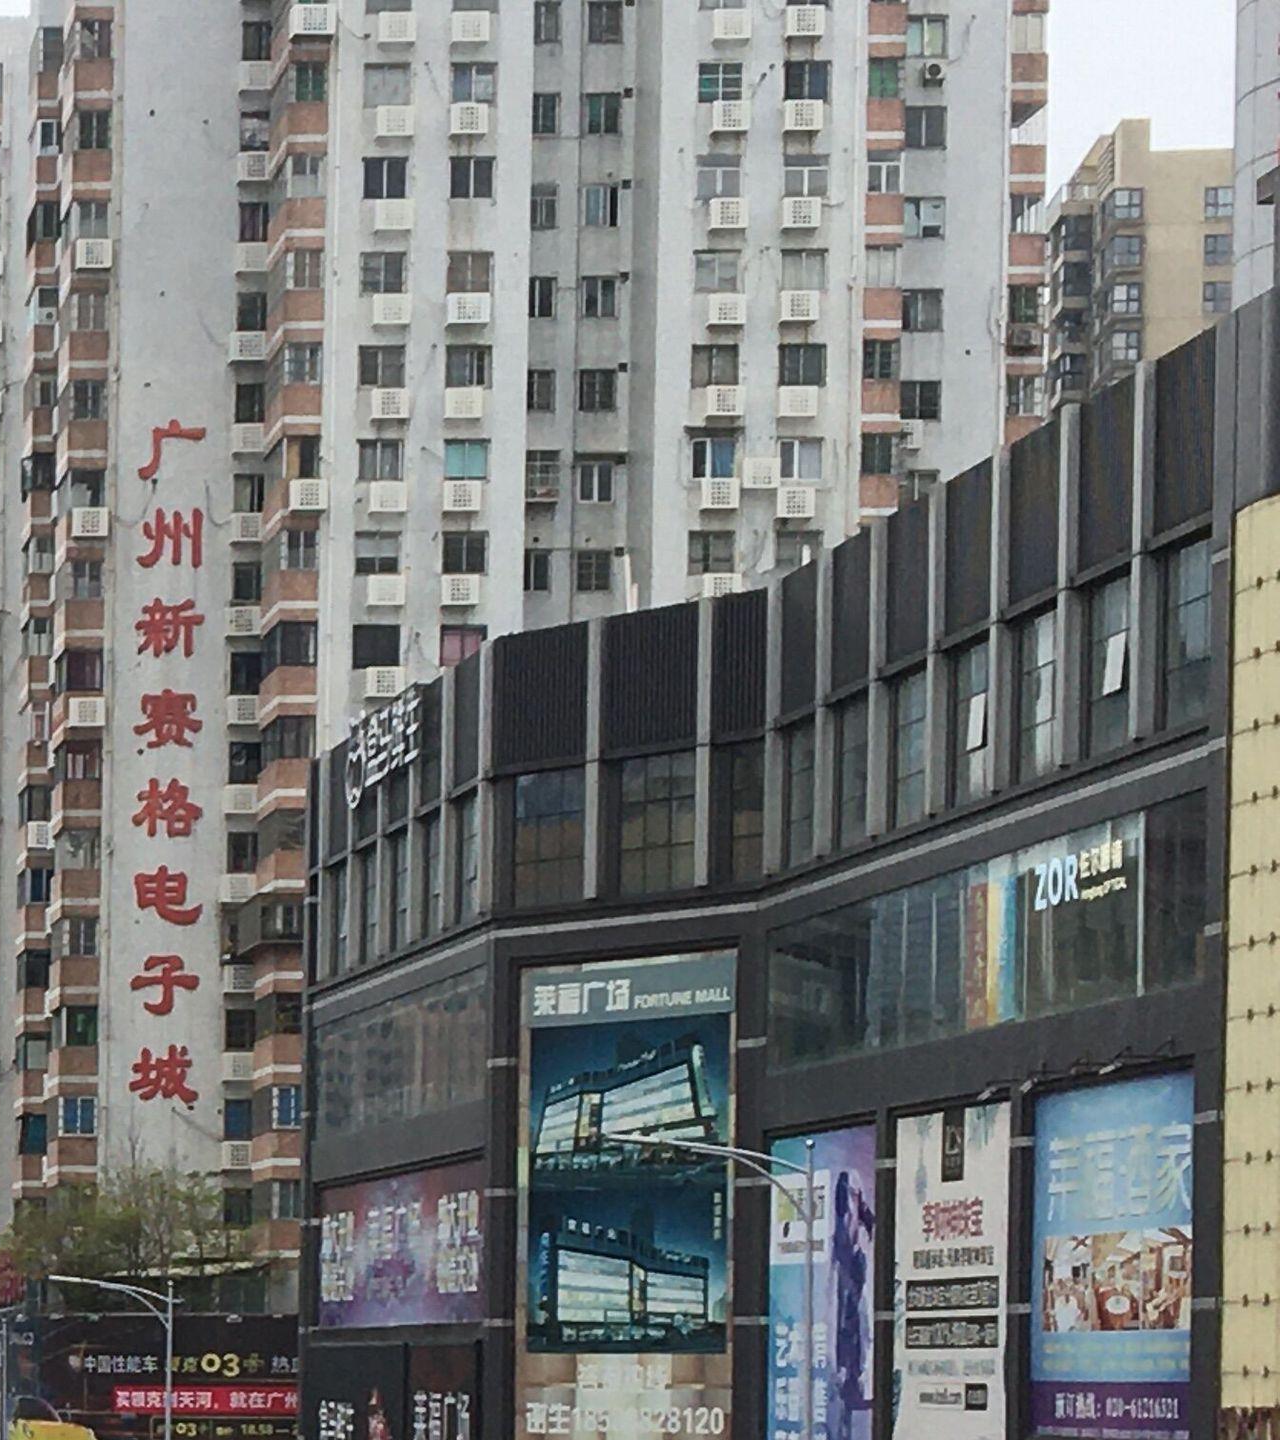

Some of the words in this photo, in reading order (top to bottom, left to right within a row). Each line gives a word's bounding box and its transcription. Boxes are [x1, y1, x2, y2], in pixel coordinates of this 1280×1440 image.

[130, 417, 208, 1105] 广州新赛格电子城
[695, 983, 731, 1003] MALL
